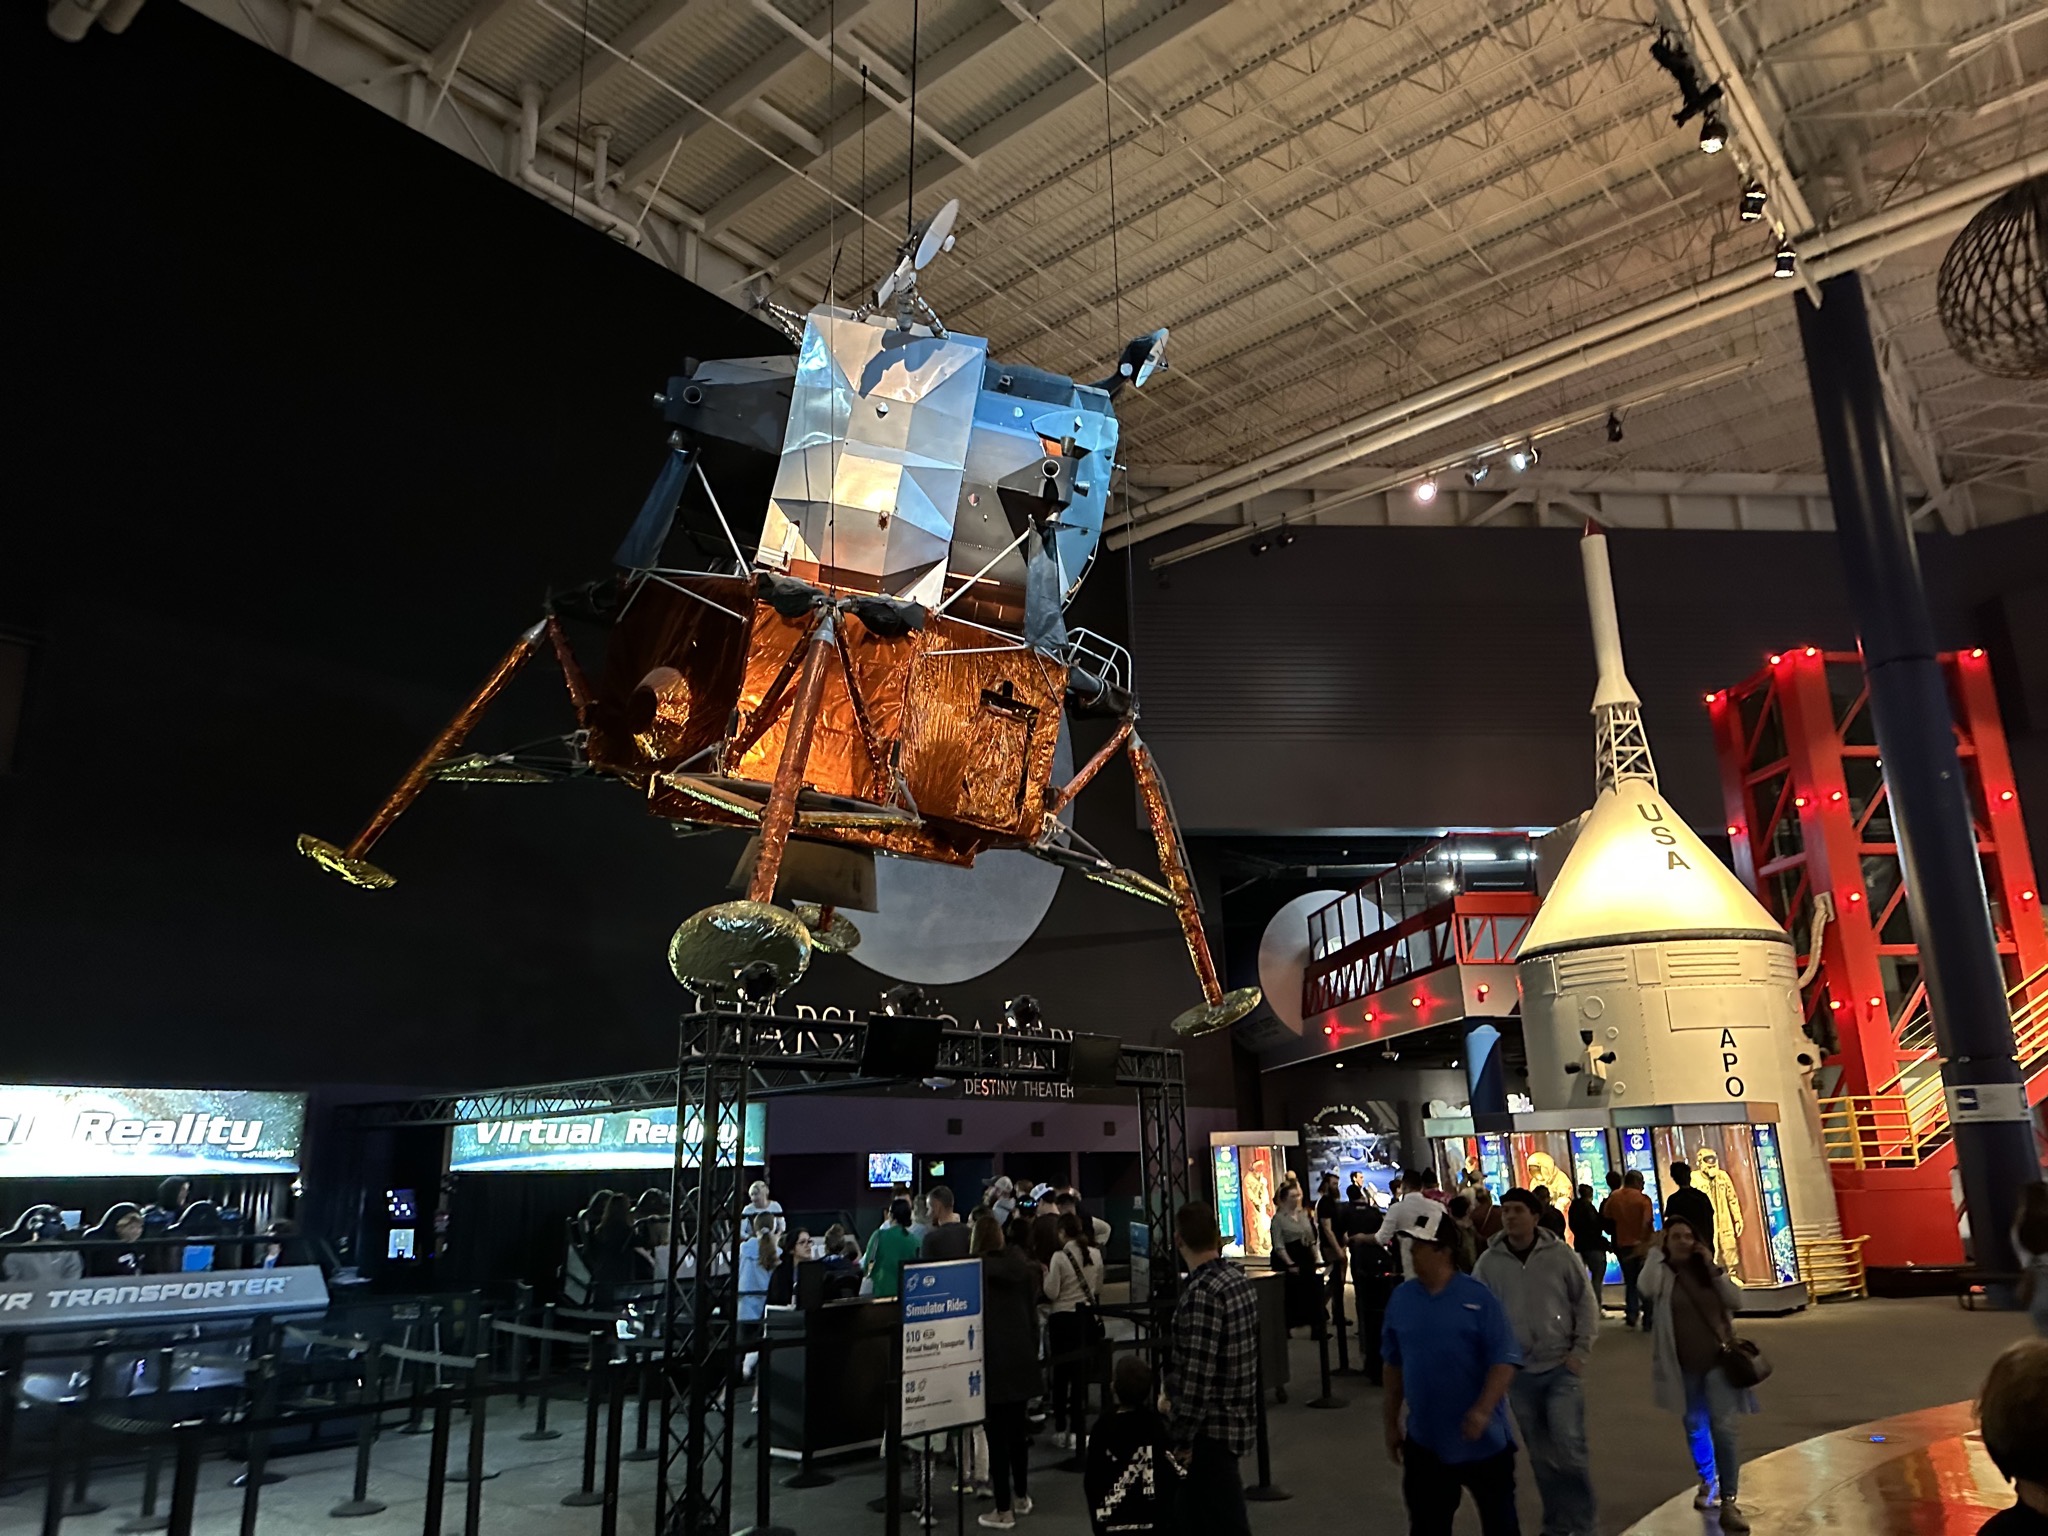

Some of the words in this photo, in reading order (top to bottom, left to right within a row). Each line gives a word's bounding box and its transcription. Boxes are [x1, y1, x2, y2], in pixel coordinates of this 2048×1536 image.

[1637, 803, 1691, 870] USA
[1720, 1028, 1744, 1097] APO
[964, 1078, 1016, 1096] DESTINY
[1023, 1081, 1074, 1098] THEATER
[73, 1110, 263, 1152] Reality
[477, 1117, 604, 1145] Virtual
[47, 1276, 288, 1309] TRANSPORTER
[906, 1301, 946, 1317] Simulator
[946, 1298, 968, 1312] Rides
[906, 1330, 920, 1343] $10
